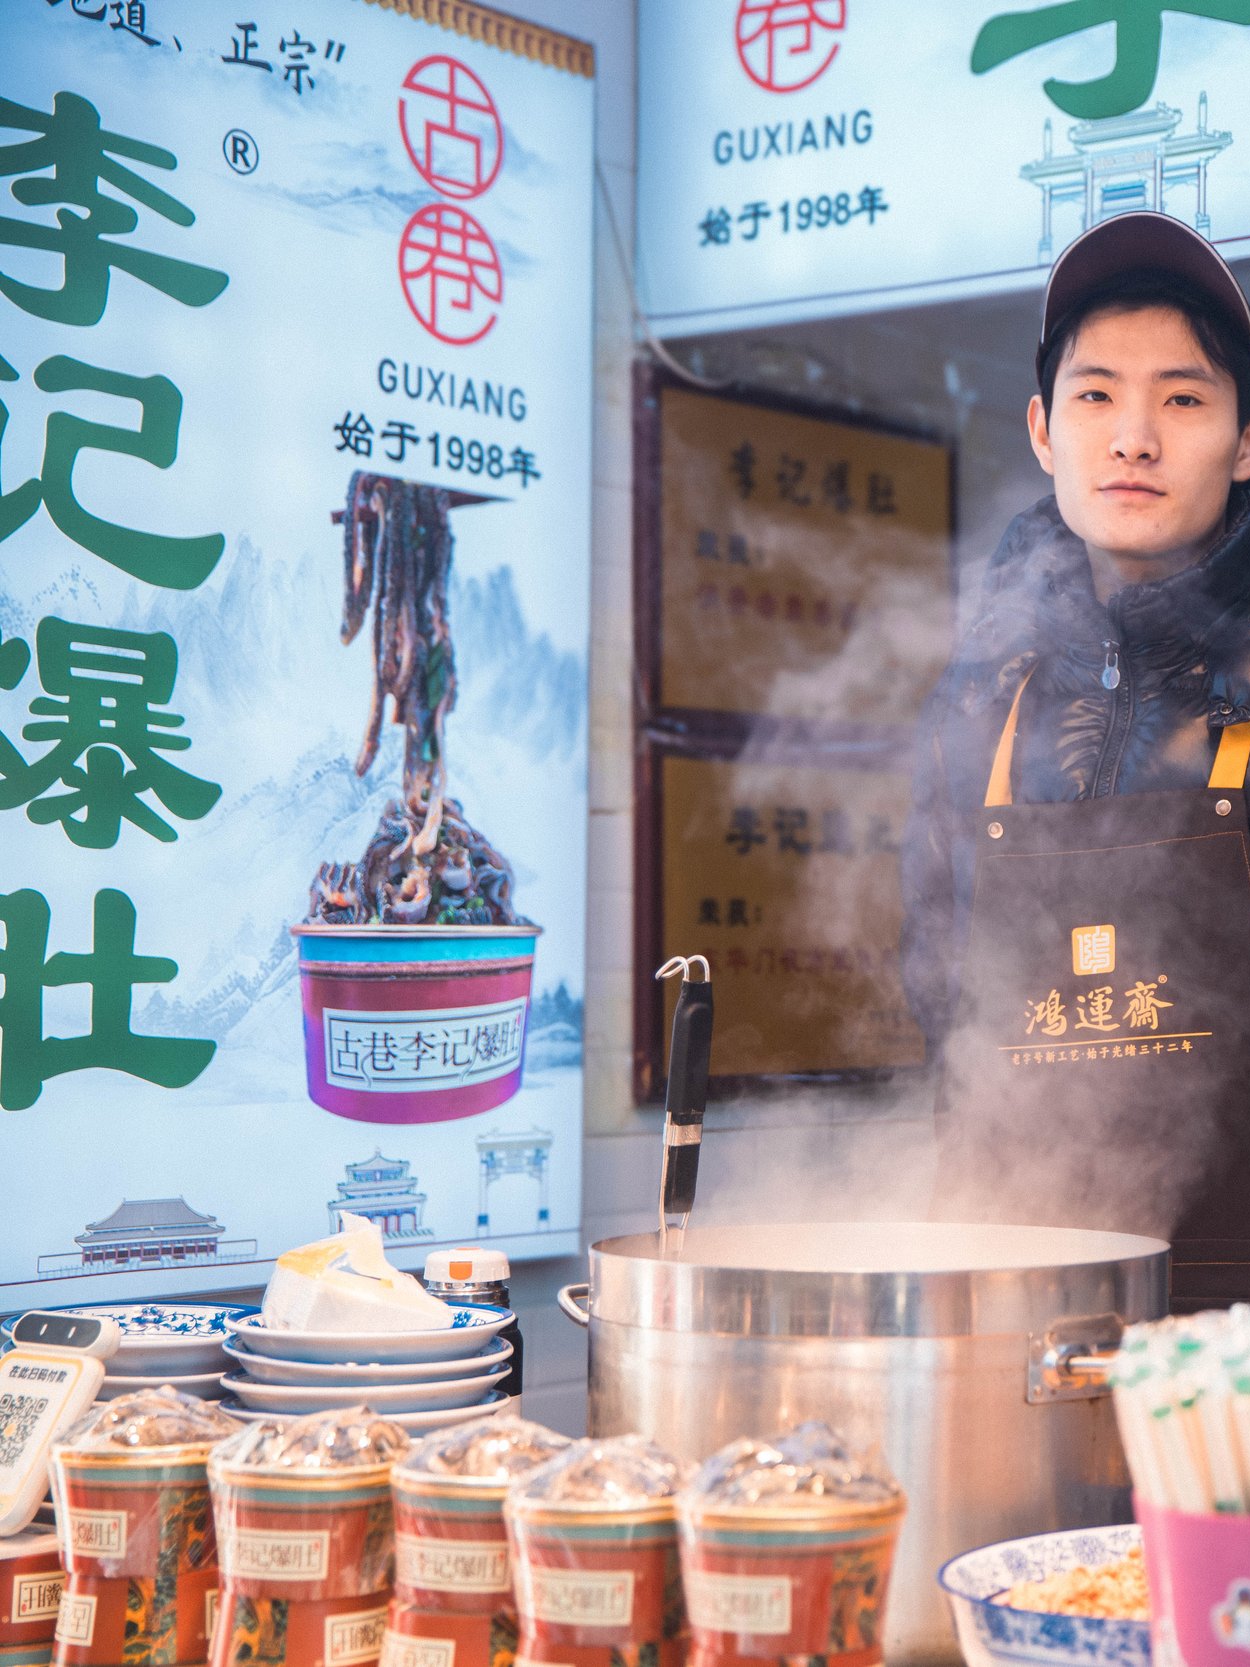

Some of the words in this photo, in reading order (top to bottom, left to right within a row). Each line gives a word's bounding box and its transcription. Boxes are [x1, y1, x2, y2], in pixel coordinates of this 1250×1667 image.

[713, 109, 874, 166] GUXIANG
[698, 185, 890, 247] 始于1998年
[378, 358, 528, 422] GUXIANG
[333, 411, 542, 489] 始于1998年
[333, 1019, 520, 1072] 古巷李记爆肚
